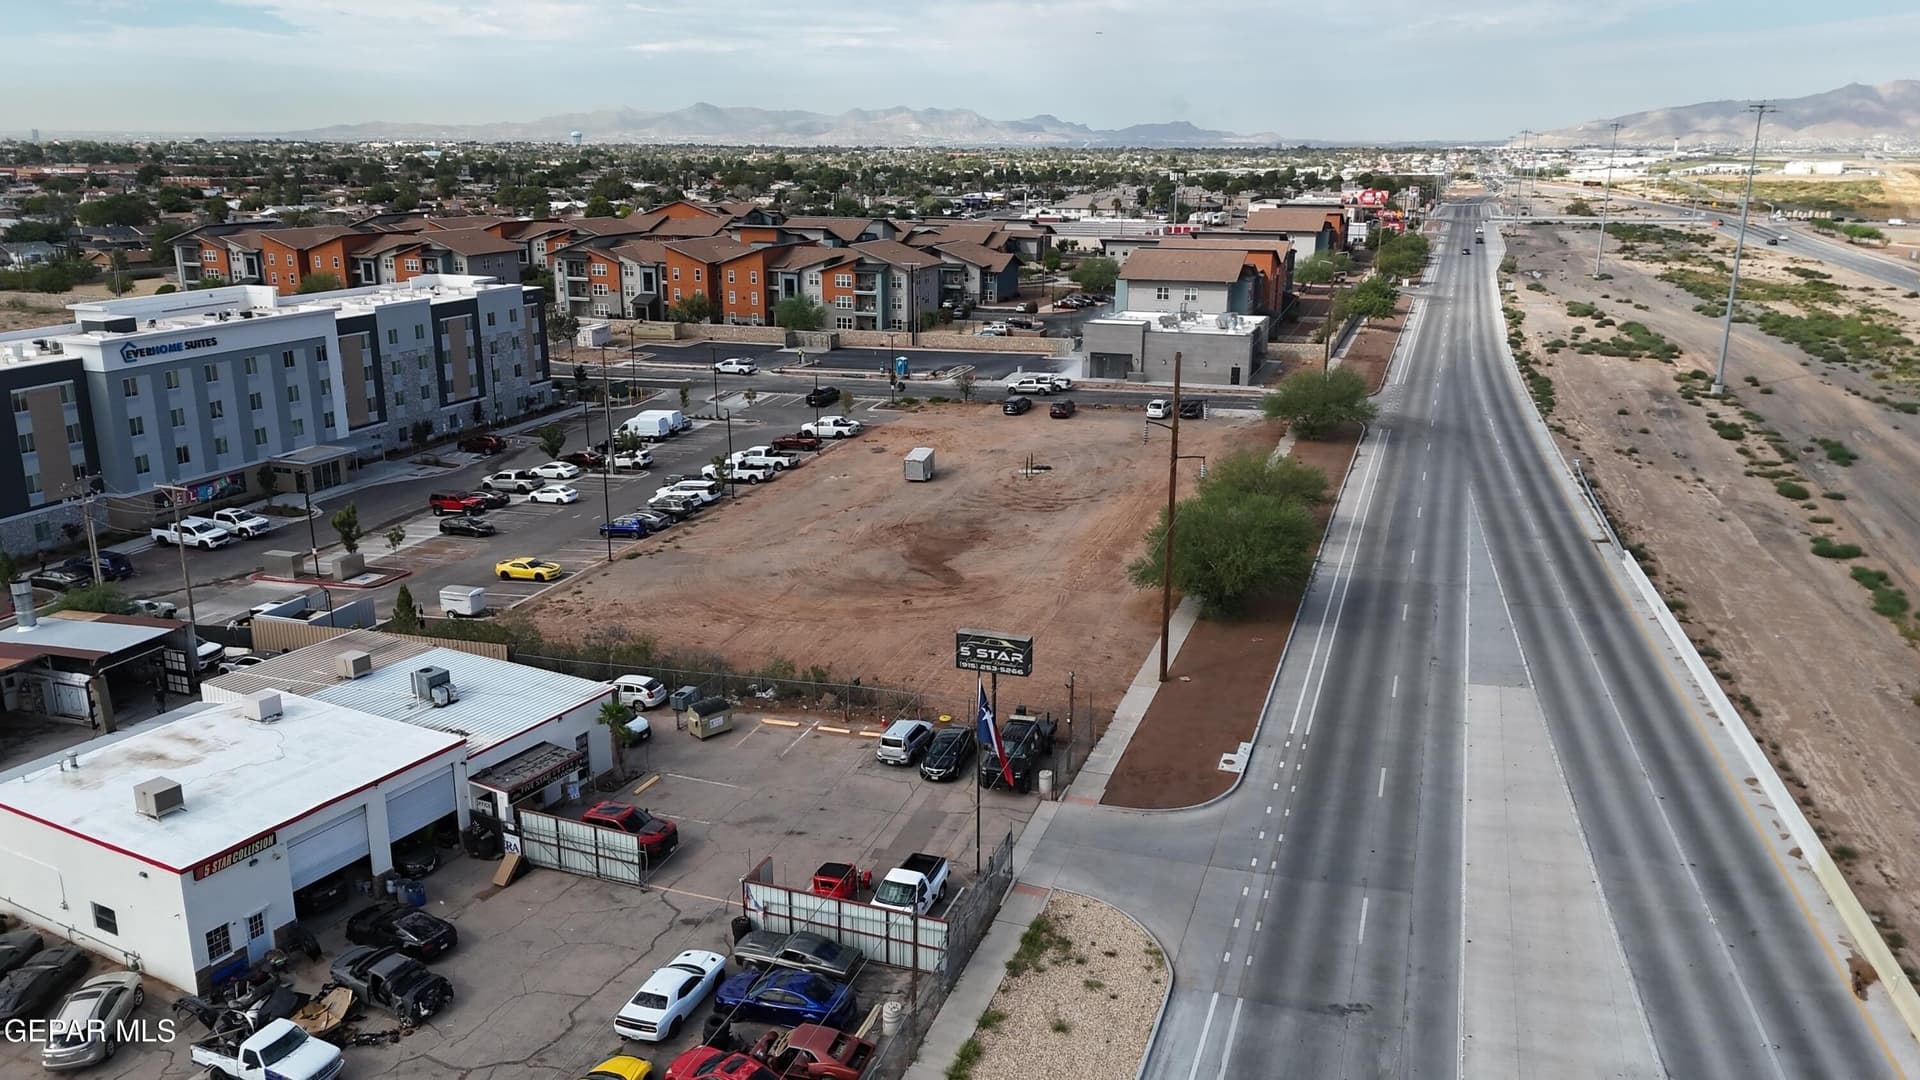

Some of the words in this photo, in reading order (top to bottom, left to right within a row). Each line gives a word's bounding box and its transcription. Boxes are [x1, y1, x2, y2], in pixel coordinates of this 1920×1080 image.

[125, 342, 183, 359] EVERHOME
[184, 337, 218, 350] SUITES
[960, 646, 971, 656] 5
[976, 648, 1024, 663] STAR
[204, 863, 211, 876] 5
[212, 854, 232, 873] STAR
[232, 834, 275, 862] COLLISION
